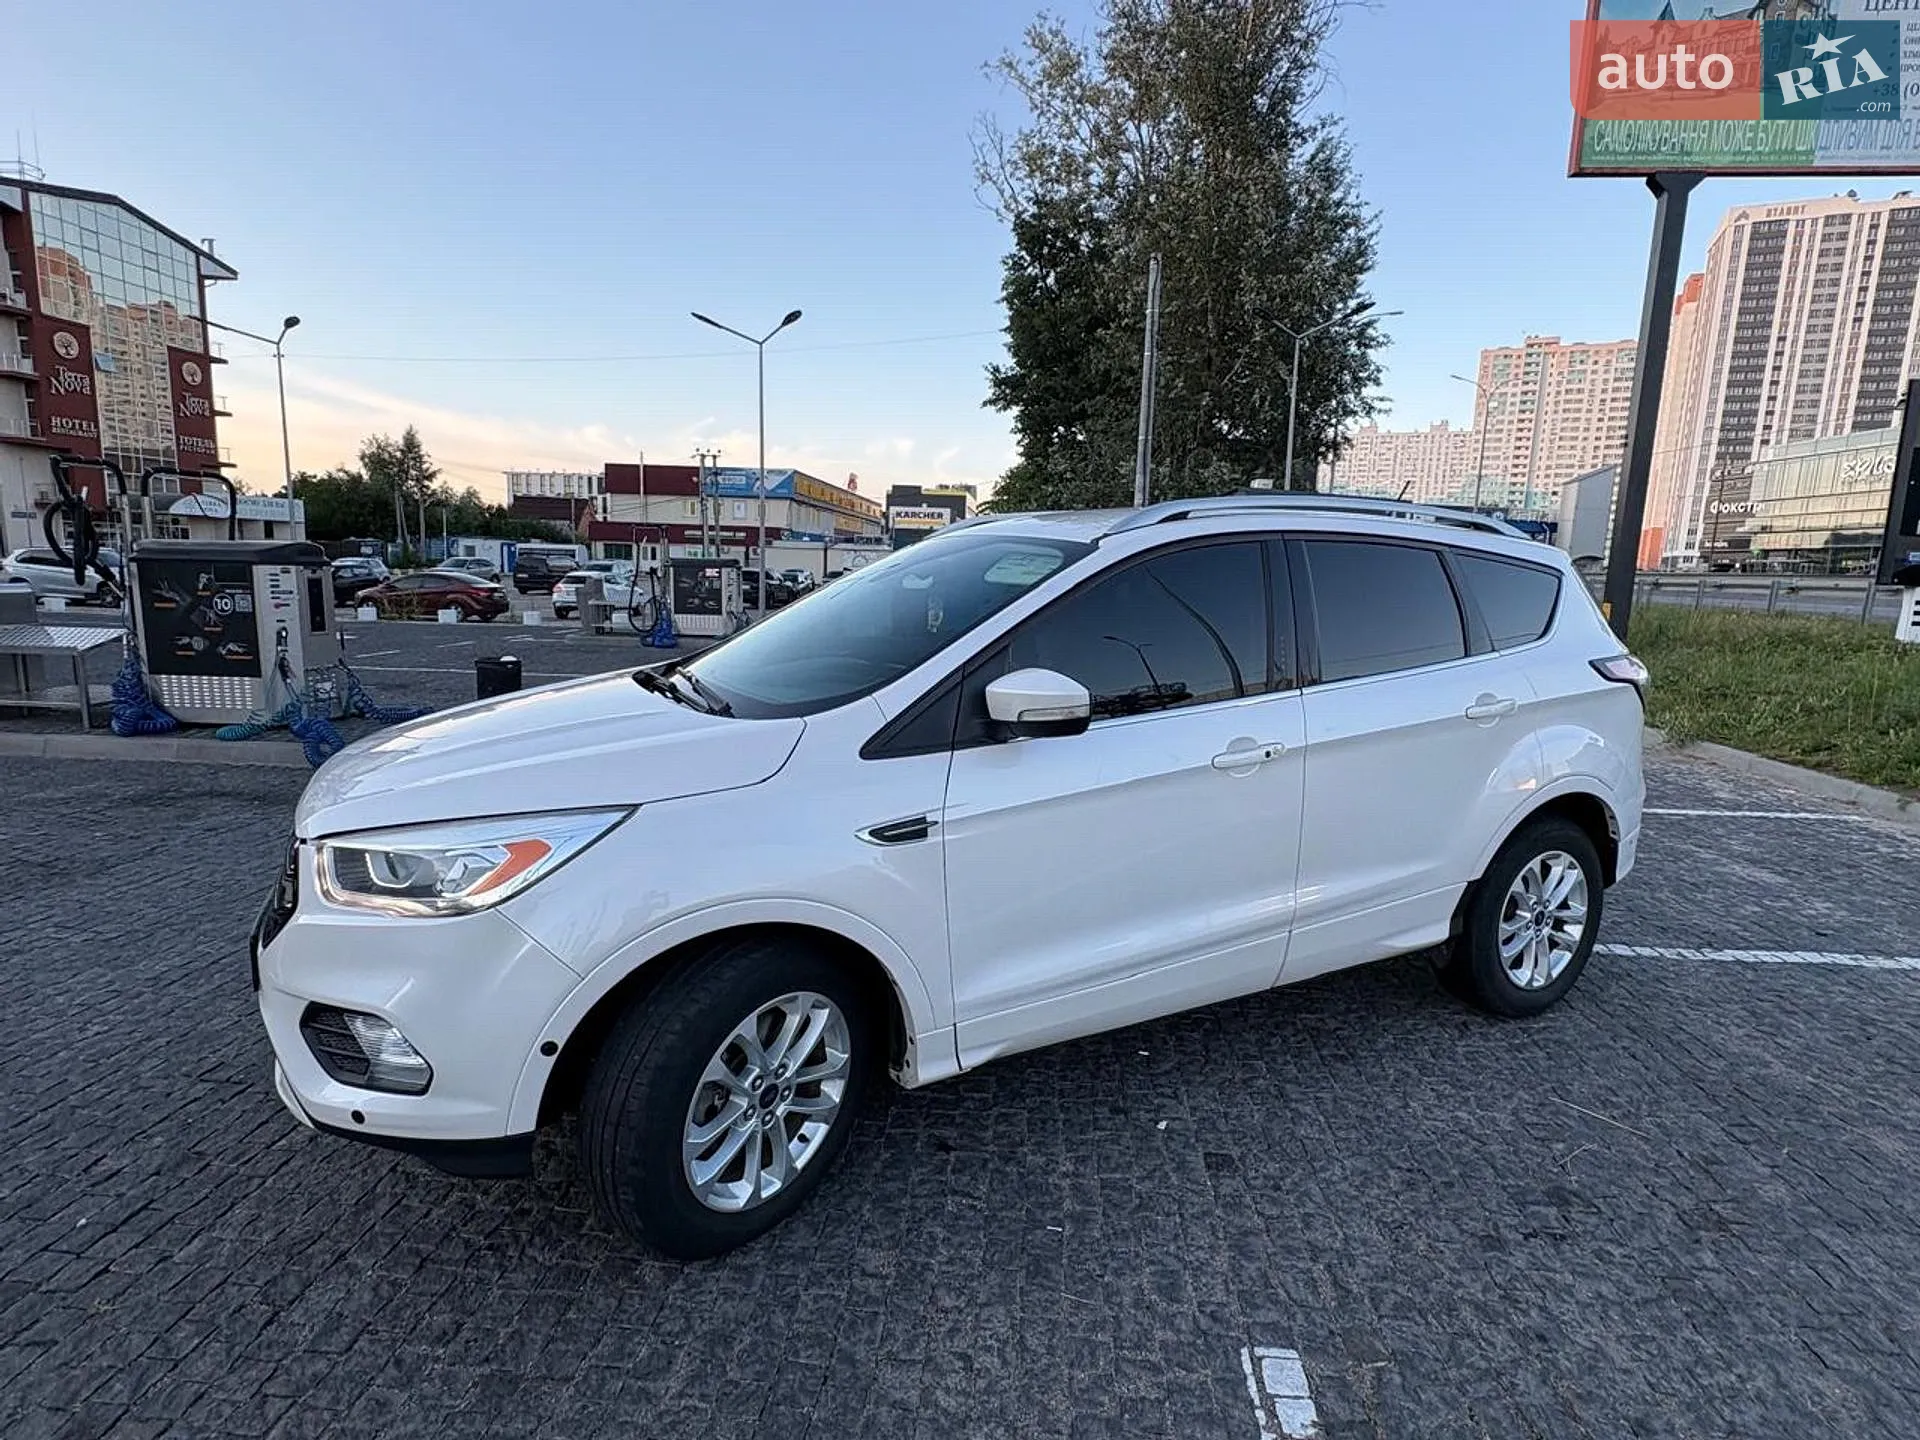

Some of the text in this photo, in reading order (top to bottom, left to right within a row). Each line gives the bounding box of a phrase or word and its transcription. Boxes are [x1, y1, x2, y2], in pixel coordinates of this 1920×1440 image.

[1710, 119, 1757, 151] МОЖЕ
[1757, 119, 1796, 151] БУТИ
[55, 365, 90, 384] Terra
[49, 376, 91, 395] Nova
[51, 416, 97, 432] HOTEL
